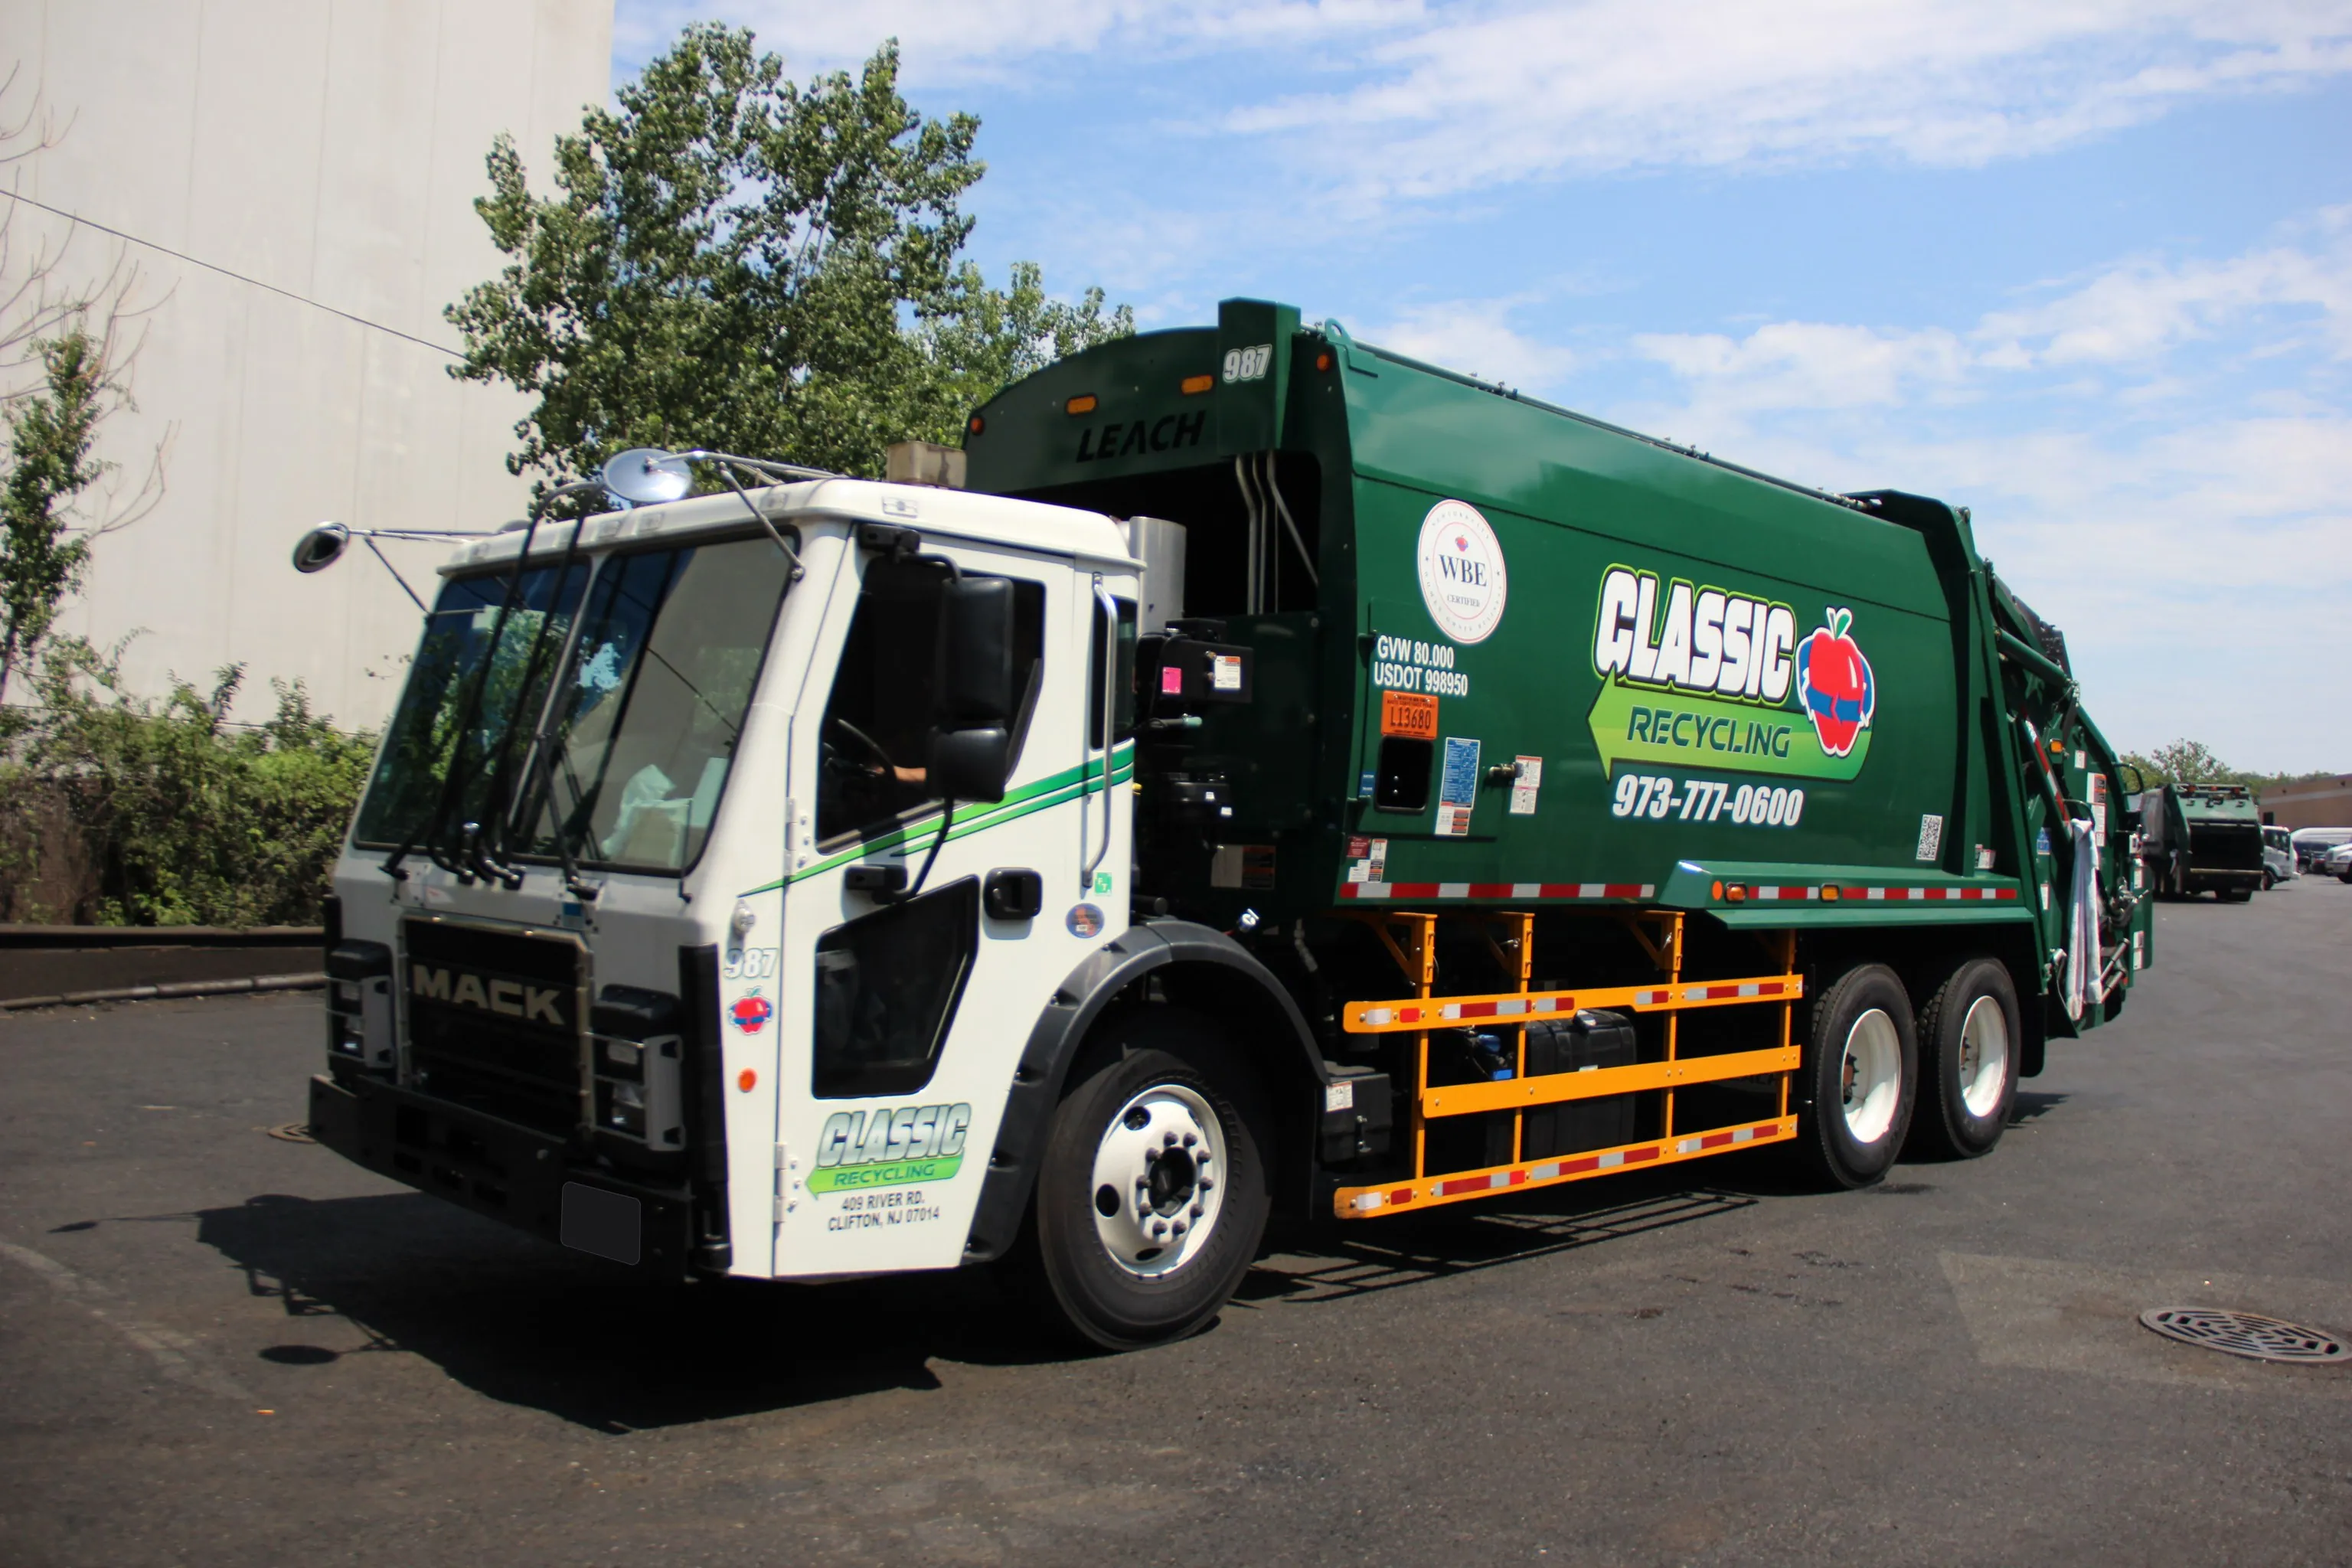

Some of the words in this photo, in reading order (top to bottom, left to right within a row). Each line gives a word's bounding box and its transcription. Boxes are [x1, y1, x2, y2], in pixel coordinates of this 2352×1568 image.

[1223, 345, 1272, 383] 987
[1076, 410, 1207, 462] LEACH
[1439, 554, 1487, 587] WBE
[1377, 635, 1412, 662] GVW
[1414, 641, 1454, 668] 80.000
[1594, 567, 1796, 701] CLASSIC
[1374, 662, 1423, 690] USDOT
[1425, 668, 1468, 697] 998950
[1390, 706, 1431, 730] L13680
[1626, 705, 1792, 759] RECYCLING
[1612, 773, 1805, 826] 973-777-0600
[722, 947, 778, 979] 987
[413, 965, 565, 1026] MACK
[816, 1102, 972, 1168] CLASSIC
[833, 1163, 936, 1187] RECYCLING
[841, 1197, 864, 1211] 409
[867, 1193, 903, 1210] RIVER
[906, 1191, 926, 1205] RD.
[828, 1213, 884, 1232] CLIFTON,
[887, 1210, 903, 1225] NJ
[906, 1206, 940, 1223] 07014
